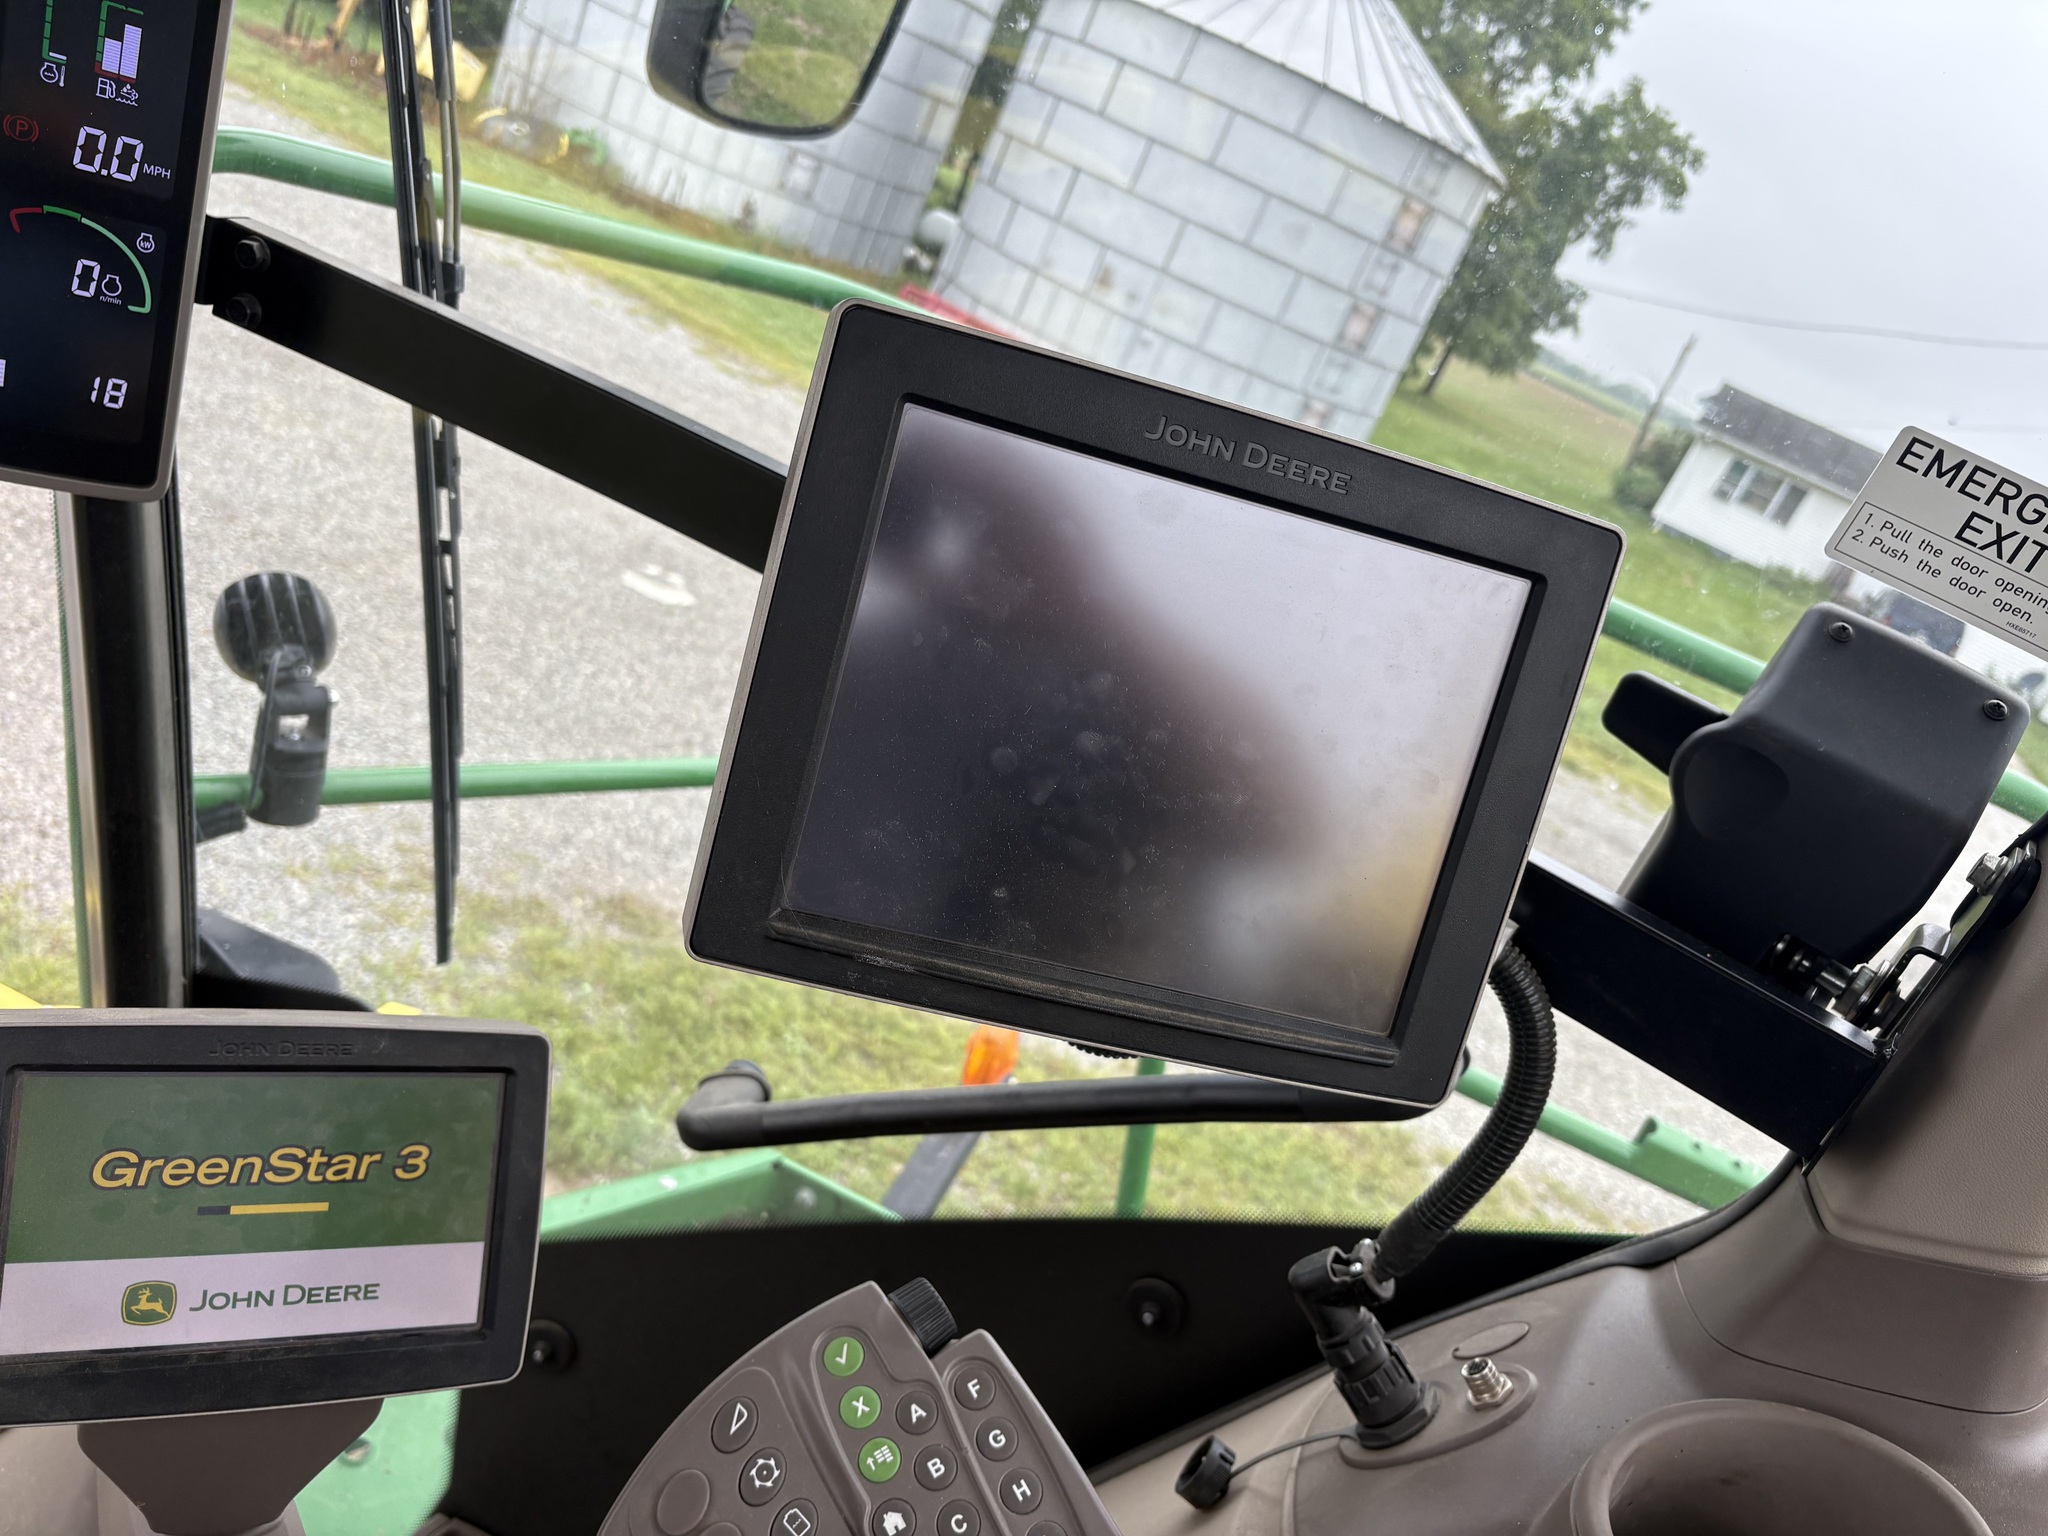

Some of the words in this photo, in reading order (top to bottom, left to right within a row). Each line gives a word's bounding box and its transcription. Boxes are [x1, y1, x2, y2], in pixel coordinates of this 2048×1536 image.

[73, 125, 144, 182] 0.0
[142, 163, 171, 180] MPH
[71, 258, 100, 298] 0
[99, 295, 122, 305] n/min
[90, 376, 128, 409] 18
[1144, 415, 1236, 462] JOHN
[1242, 441, 1352, 495] DEERE
[1896, 436, 2048, 535] EMERG
[1864, 513, 1874, 528] 1.
[1879, 520, 1913, 544] Pull
[1918, 539, 1943, 558] the
[1950, 556, 1989, 578] door
[1954, 510, 2048, 574] EXIT
[1851, 528, 1863, 543] 2.
[1869, 536, 1909, 563] Push
[1916, 559, 1942, 578] the
[1948, 576, 1987, 598] door
[1992, 598, 2033, 624] open.
[208, 1040, 271, 1057] JOHN
[277, 1040, 353, 1057] DEERE
[91, 1145, 382, 1189] GreenStar
[392, 1143, 432, 1182] 3
[189, 1288, 275, 1313] JOHN
[282, 1282, 380, 1306] DEERE
[967, 1378, 981, 1399] F
[910, 1403, 927, 1424] A
[988, 1429, 1006, 1448] G
[926, 1458, 945, 1479] B
[1011, 1478, 1031, 1502] H
[951, 1513, 968, 1534] C
